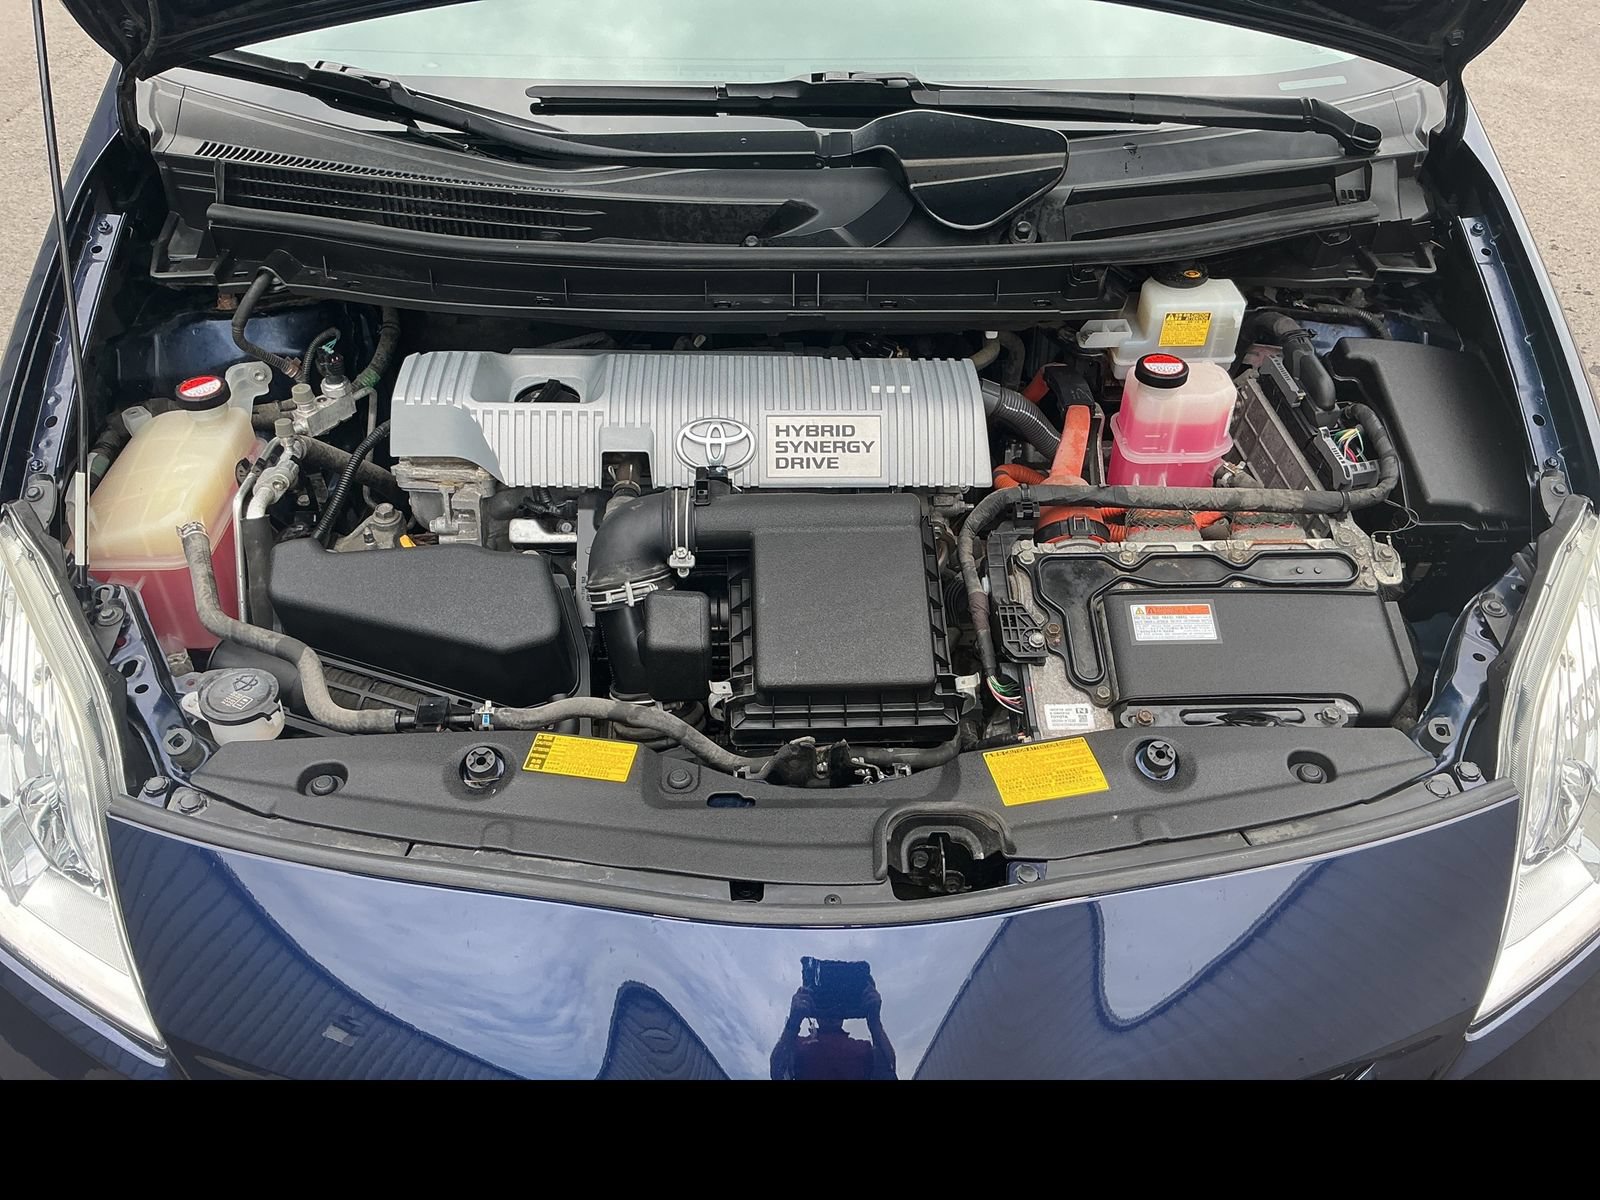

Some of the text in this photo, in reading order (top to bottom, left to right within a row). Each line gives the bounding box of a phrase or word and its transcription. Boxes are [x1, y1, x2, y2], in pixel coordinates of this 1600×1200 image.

[775, 424, 856, 438] HYBRID
[775, 440, 876, 454] SYNERGY
[775, 457, 840, 469] DRIVE
